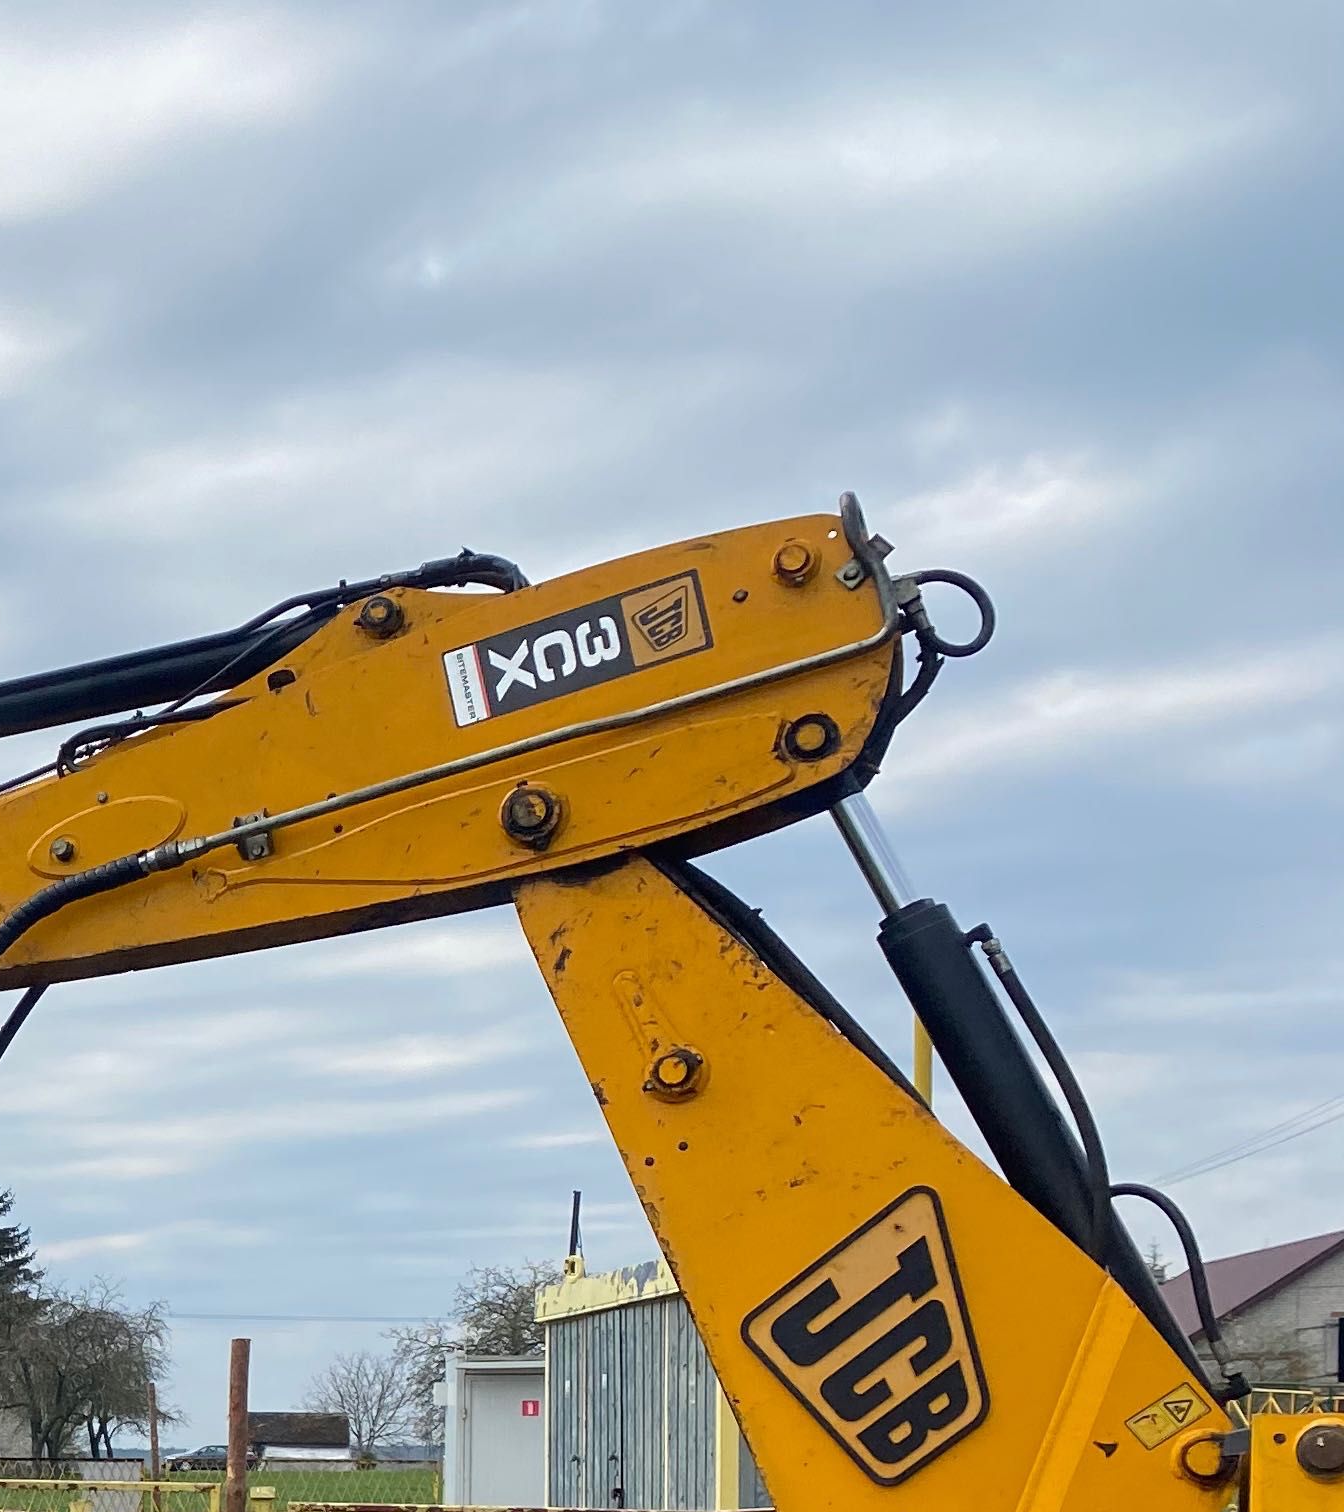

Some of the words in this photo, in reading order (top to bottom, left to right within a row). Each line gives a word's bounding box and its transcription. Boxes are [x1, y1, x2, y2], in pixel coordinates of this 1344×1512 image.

[487, 615, 622, 702] 3CX
[639, 596, 683, 648] JCB
[456, 652, 477, 720] SITEMASTER
[770, 1235, 969, 1464] JCB
